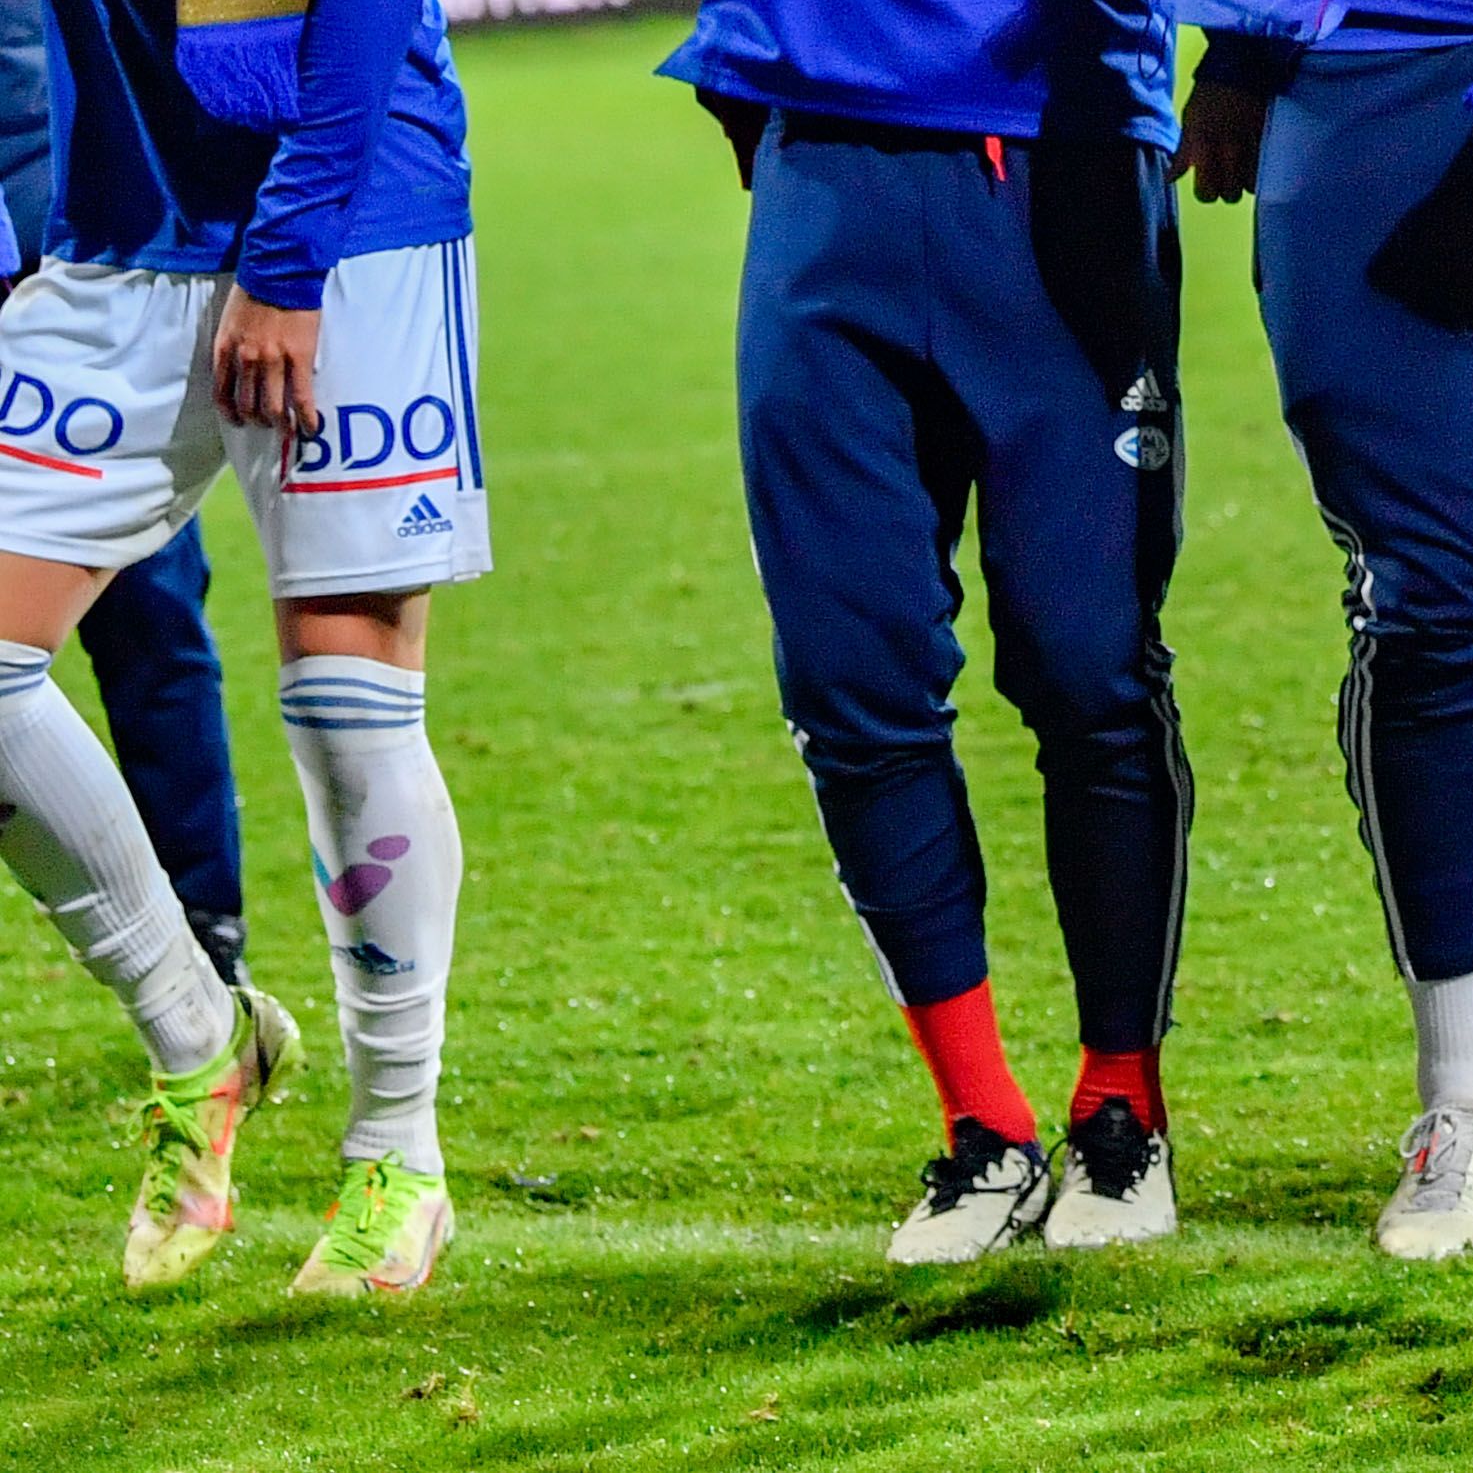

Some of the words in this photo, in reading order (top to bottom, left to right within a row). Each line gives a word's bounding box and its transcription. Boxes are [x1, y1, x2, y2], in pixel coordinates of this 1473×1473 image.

[0, 371, 124, 456] DO
[296, 394, 457, 473] BDO
[398, 518, 454, 539] adidas
